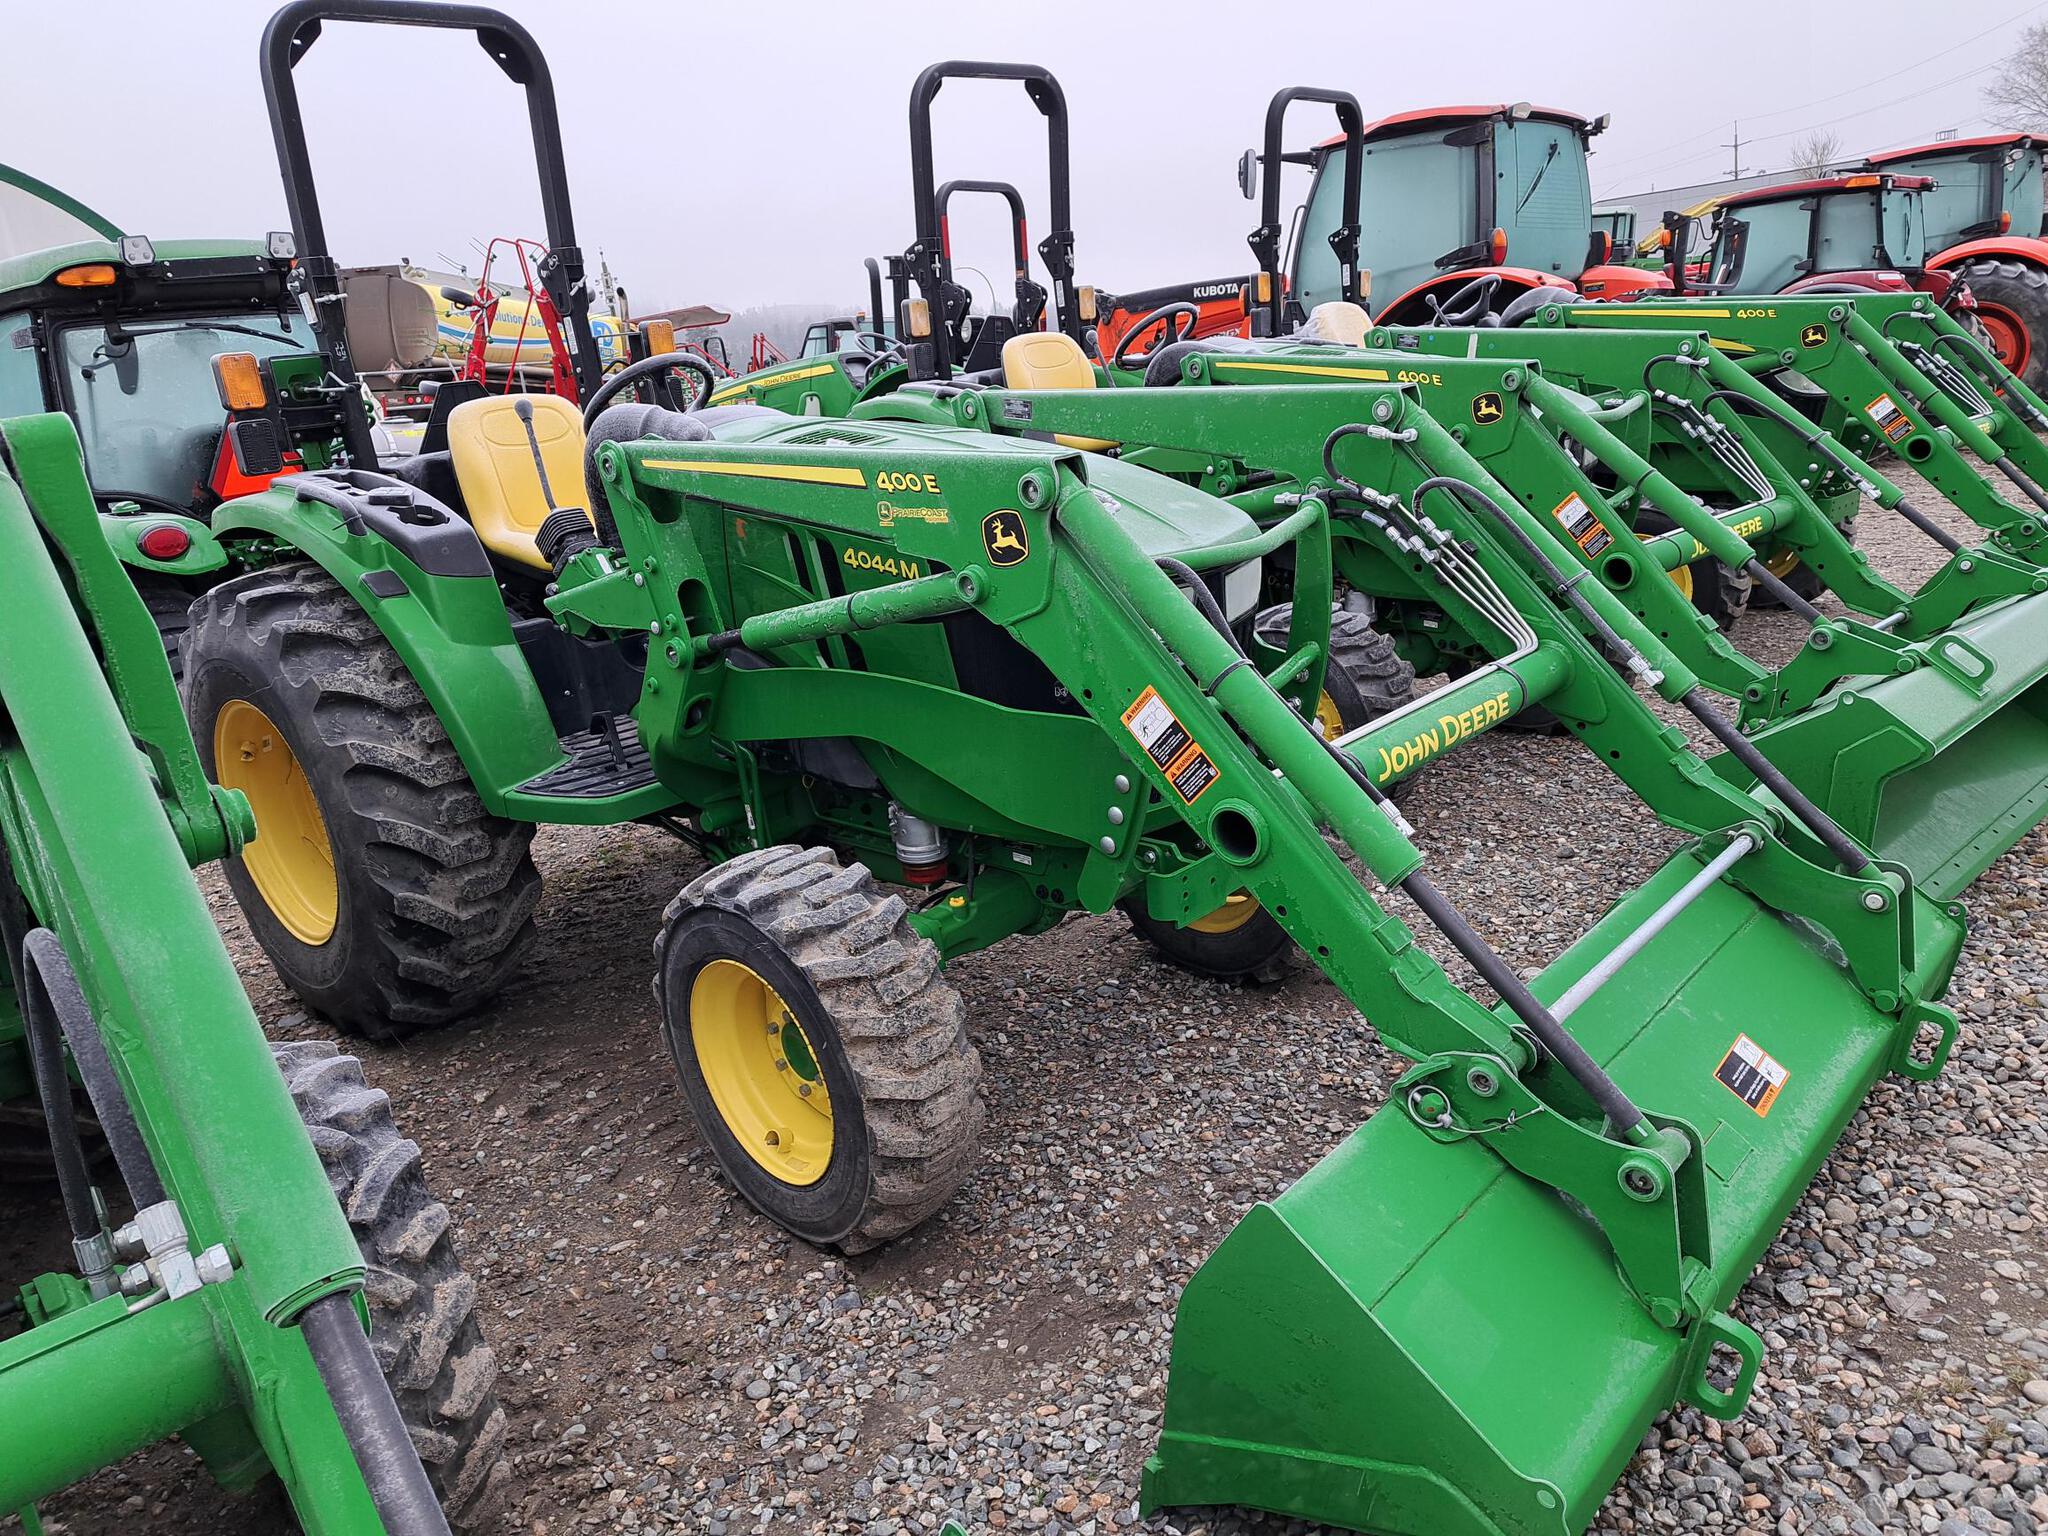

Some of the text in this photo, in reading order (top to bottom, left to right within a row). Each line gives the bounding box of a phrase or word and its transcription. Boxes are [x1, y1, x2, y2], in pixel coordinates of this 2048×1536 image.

[1193, 283, 1239, 298] KUBOTA
[1736, 309, 1778, 319] 400 E
[1397, 370, 1443, 387] 400 E
[876, 471, 942, 494] 400 E
[1731, 516, 1763, 537] EERE
[843, 547, 920, 580] 4044 M
[1129, 690, 1153, 716] WARNING
[1379, 691, 1510, 782] JOHN DEERE
[1174, 748, 1198, 773] WARNING
